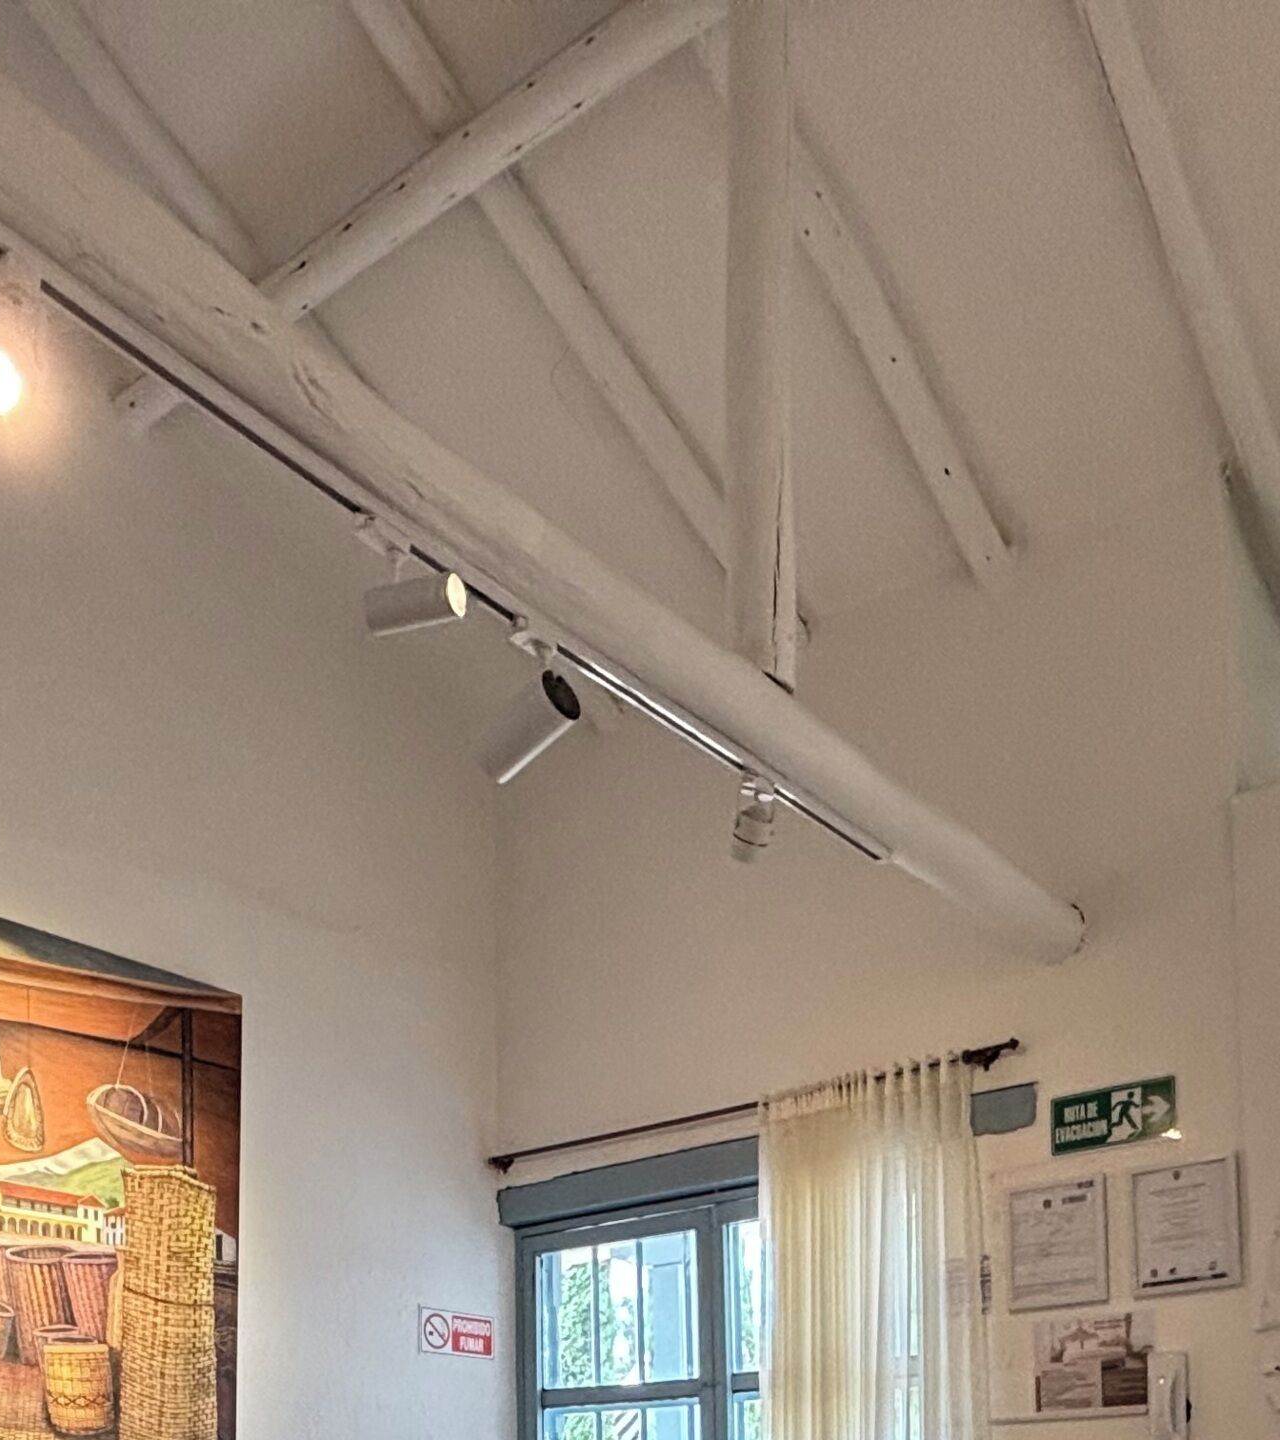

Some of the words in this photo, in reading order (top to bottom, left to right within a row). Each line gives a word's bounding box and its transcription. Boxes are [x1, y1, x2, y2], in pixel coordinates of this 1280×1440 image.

[1063, 1103, 1086, 1124] RUTA
[1086, 1100, 1099, 1118] DE
[452, 1318, 491, 1337] PROHIBIDO
[459, 1335, 485, 1353] FUMAR
